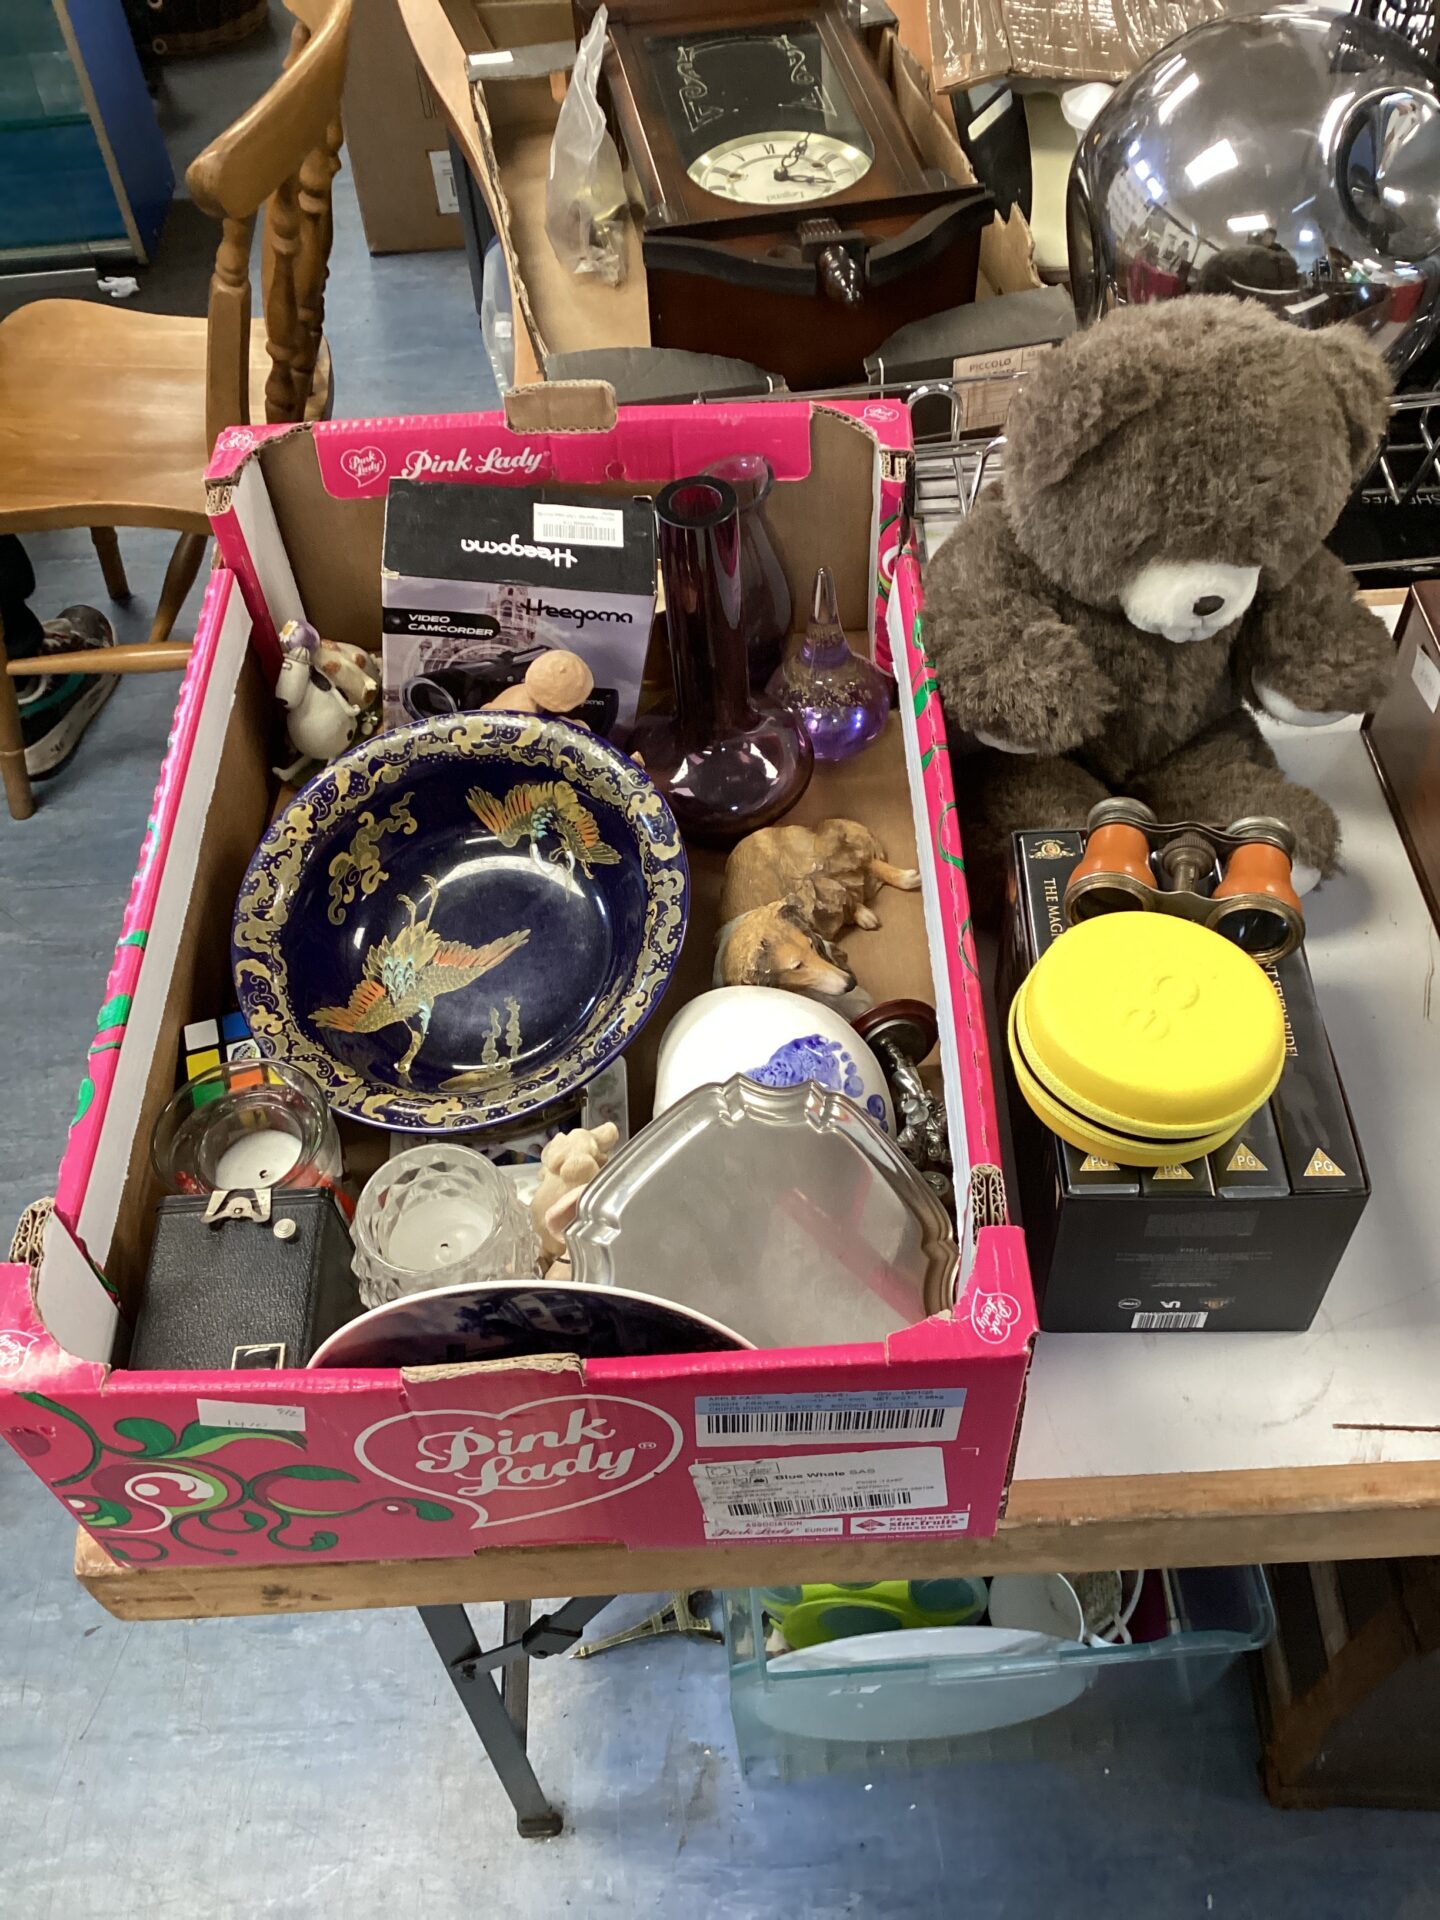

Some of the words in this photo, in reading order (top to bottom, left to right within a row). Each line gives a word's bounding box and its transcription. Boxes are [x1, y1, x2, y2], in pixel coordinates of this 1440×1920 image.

[969, 358, 1012, 373] PICCOLO
[349, 451, 376, 468] Pink
[402, 449, 472, 479] Pink
[475, 447, 543, 474] Lady
[355, 462, 382, 476] Lady
[461, 534, 578, 568] Heegoma
[408, 613, 450, 623] VIDEO
[520, 598, 633, 628] Heegoma
[408, 622, 494, 637] CAMCORDER
[1043, 877, 1059, 903] THE
[1090, 1153, 1110, 1168] PG
[1236, 1154, 1256, 1167] PG
[1313, 1160, 1335, 1173] PG
[1163, 1163, 1183, 1177] PG
[976, 1296, 998, 1331] Lady
[989, 1296, 1013, 1336] Pink
[415, 1408, 616, 1473] Pink
[454, 1443, 636, 1496] Lady
[775, 1473, 803, 1481] Blue
[806, 1471, 846, 1479] Whale
[745, 1520, 802, 1528] ASSOCIATION
[711, 1528, 753, 1537] Pink
